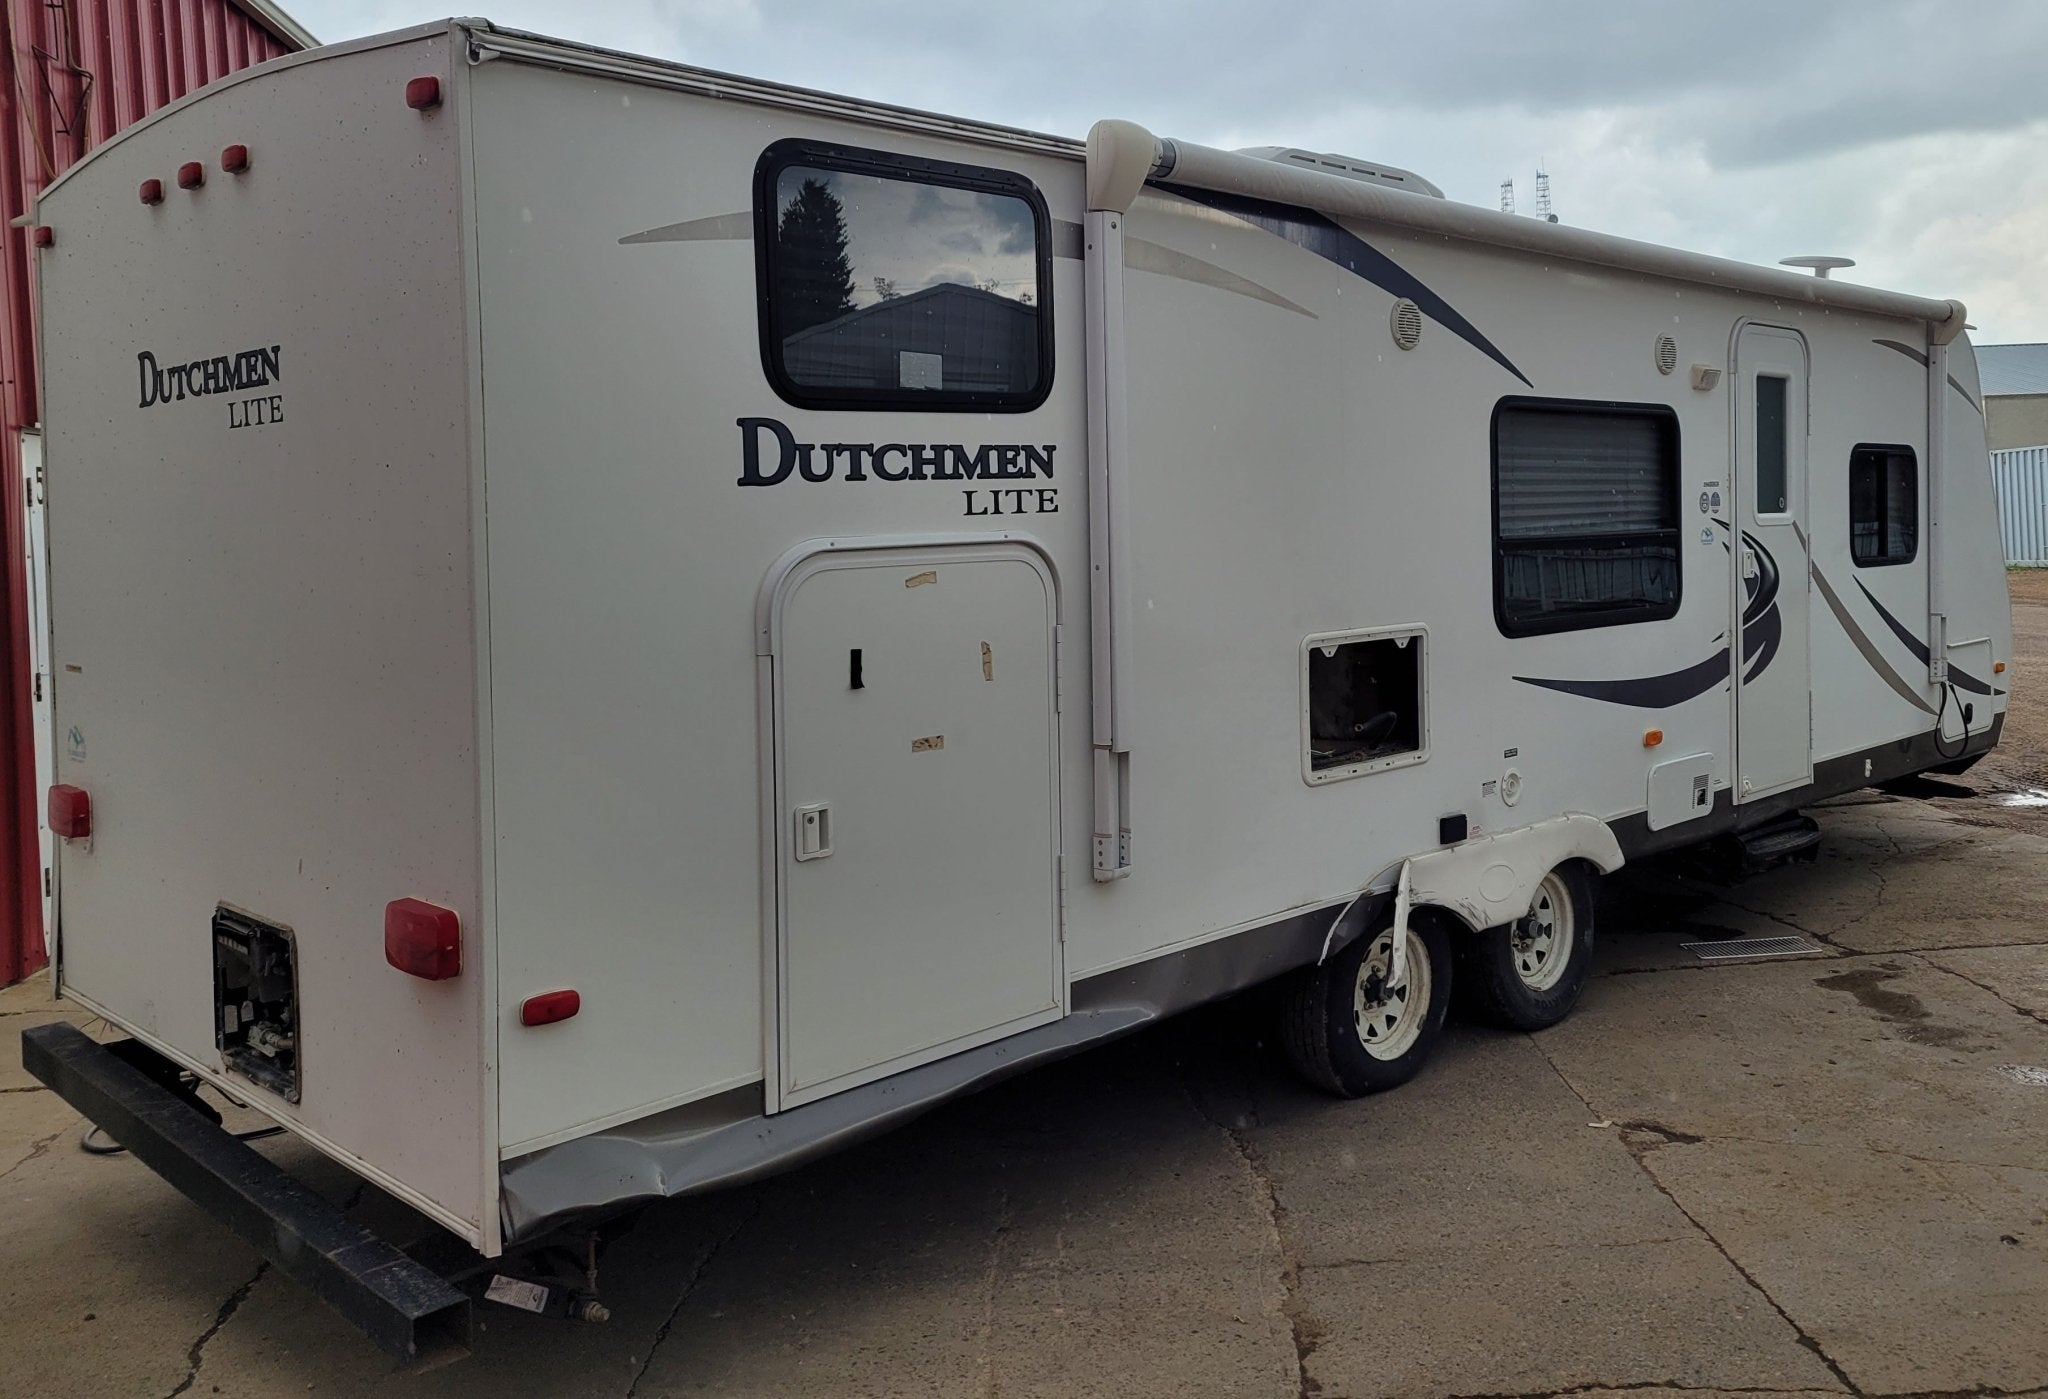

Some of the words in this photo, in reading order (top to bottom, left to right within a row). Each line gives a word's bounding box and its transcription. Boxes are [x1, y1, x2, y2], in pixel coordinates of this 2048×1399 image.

[138, 345, 281, 408] DUTCHMEN
[228, 395, 284, 429] LITE
[736, 417, 1057, 486] DUTCHMEN
[962, 489, 1059, 516] LITE
